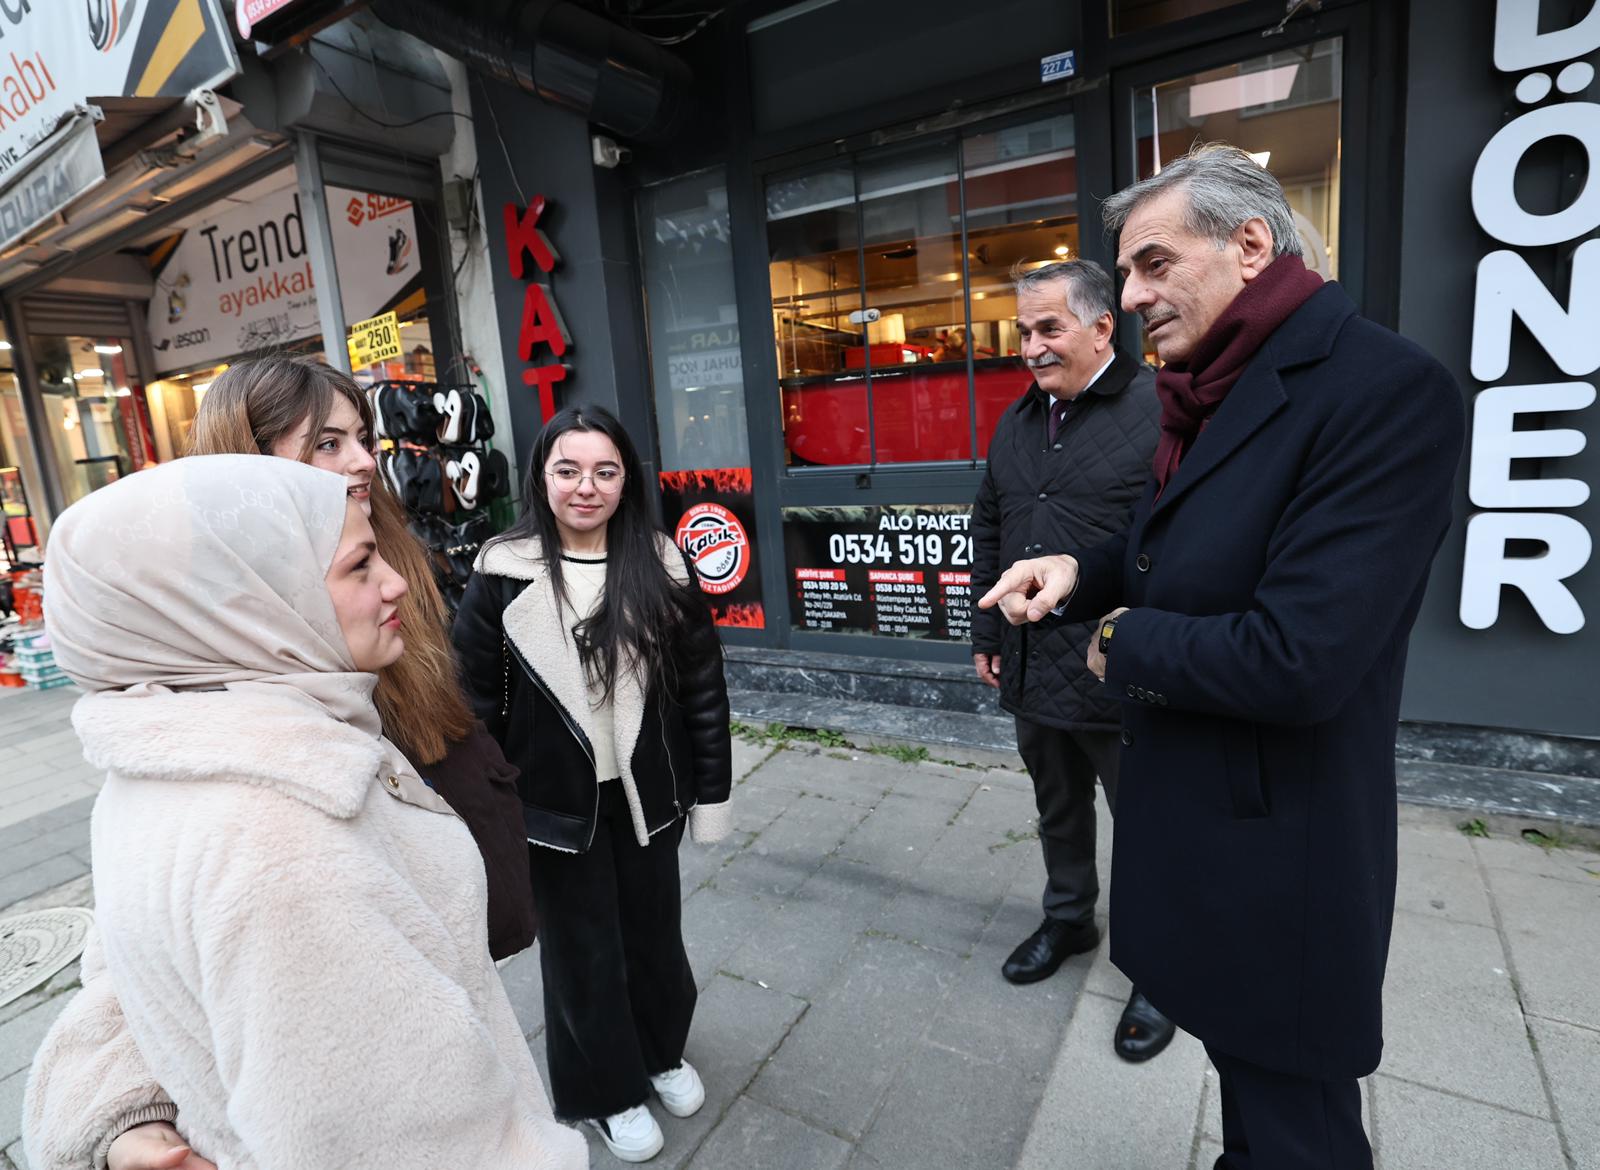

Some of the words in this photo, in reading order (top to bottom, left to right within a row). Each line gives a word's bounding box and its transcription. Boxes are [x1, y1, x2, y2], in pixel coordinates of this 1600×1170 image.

[1043, 61, 1061, 75] 227
[1063, 58, 1073, 70] A
[200, 192, 307, 283] Trend
[503, 194, 567, 425] KAT
[367, 325, 391, 349] 250
[374, 345, 398, 360] 300
[879, 515, 913, 531] ALO
[917, 514, 971, 530] PAKET
[829, 534, 892, 564] 0534
[898, 534, 943, 565] 519
[830, 582, 839, 591] 20
[906, 584, 916, 594] 20
[916, 584, 926, 594] 54
